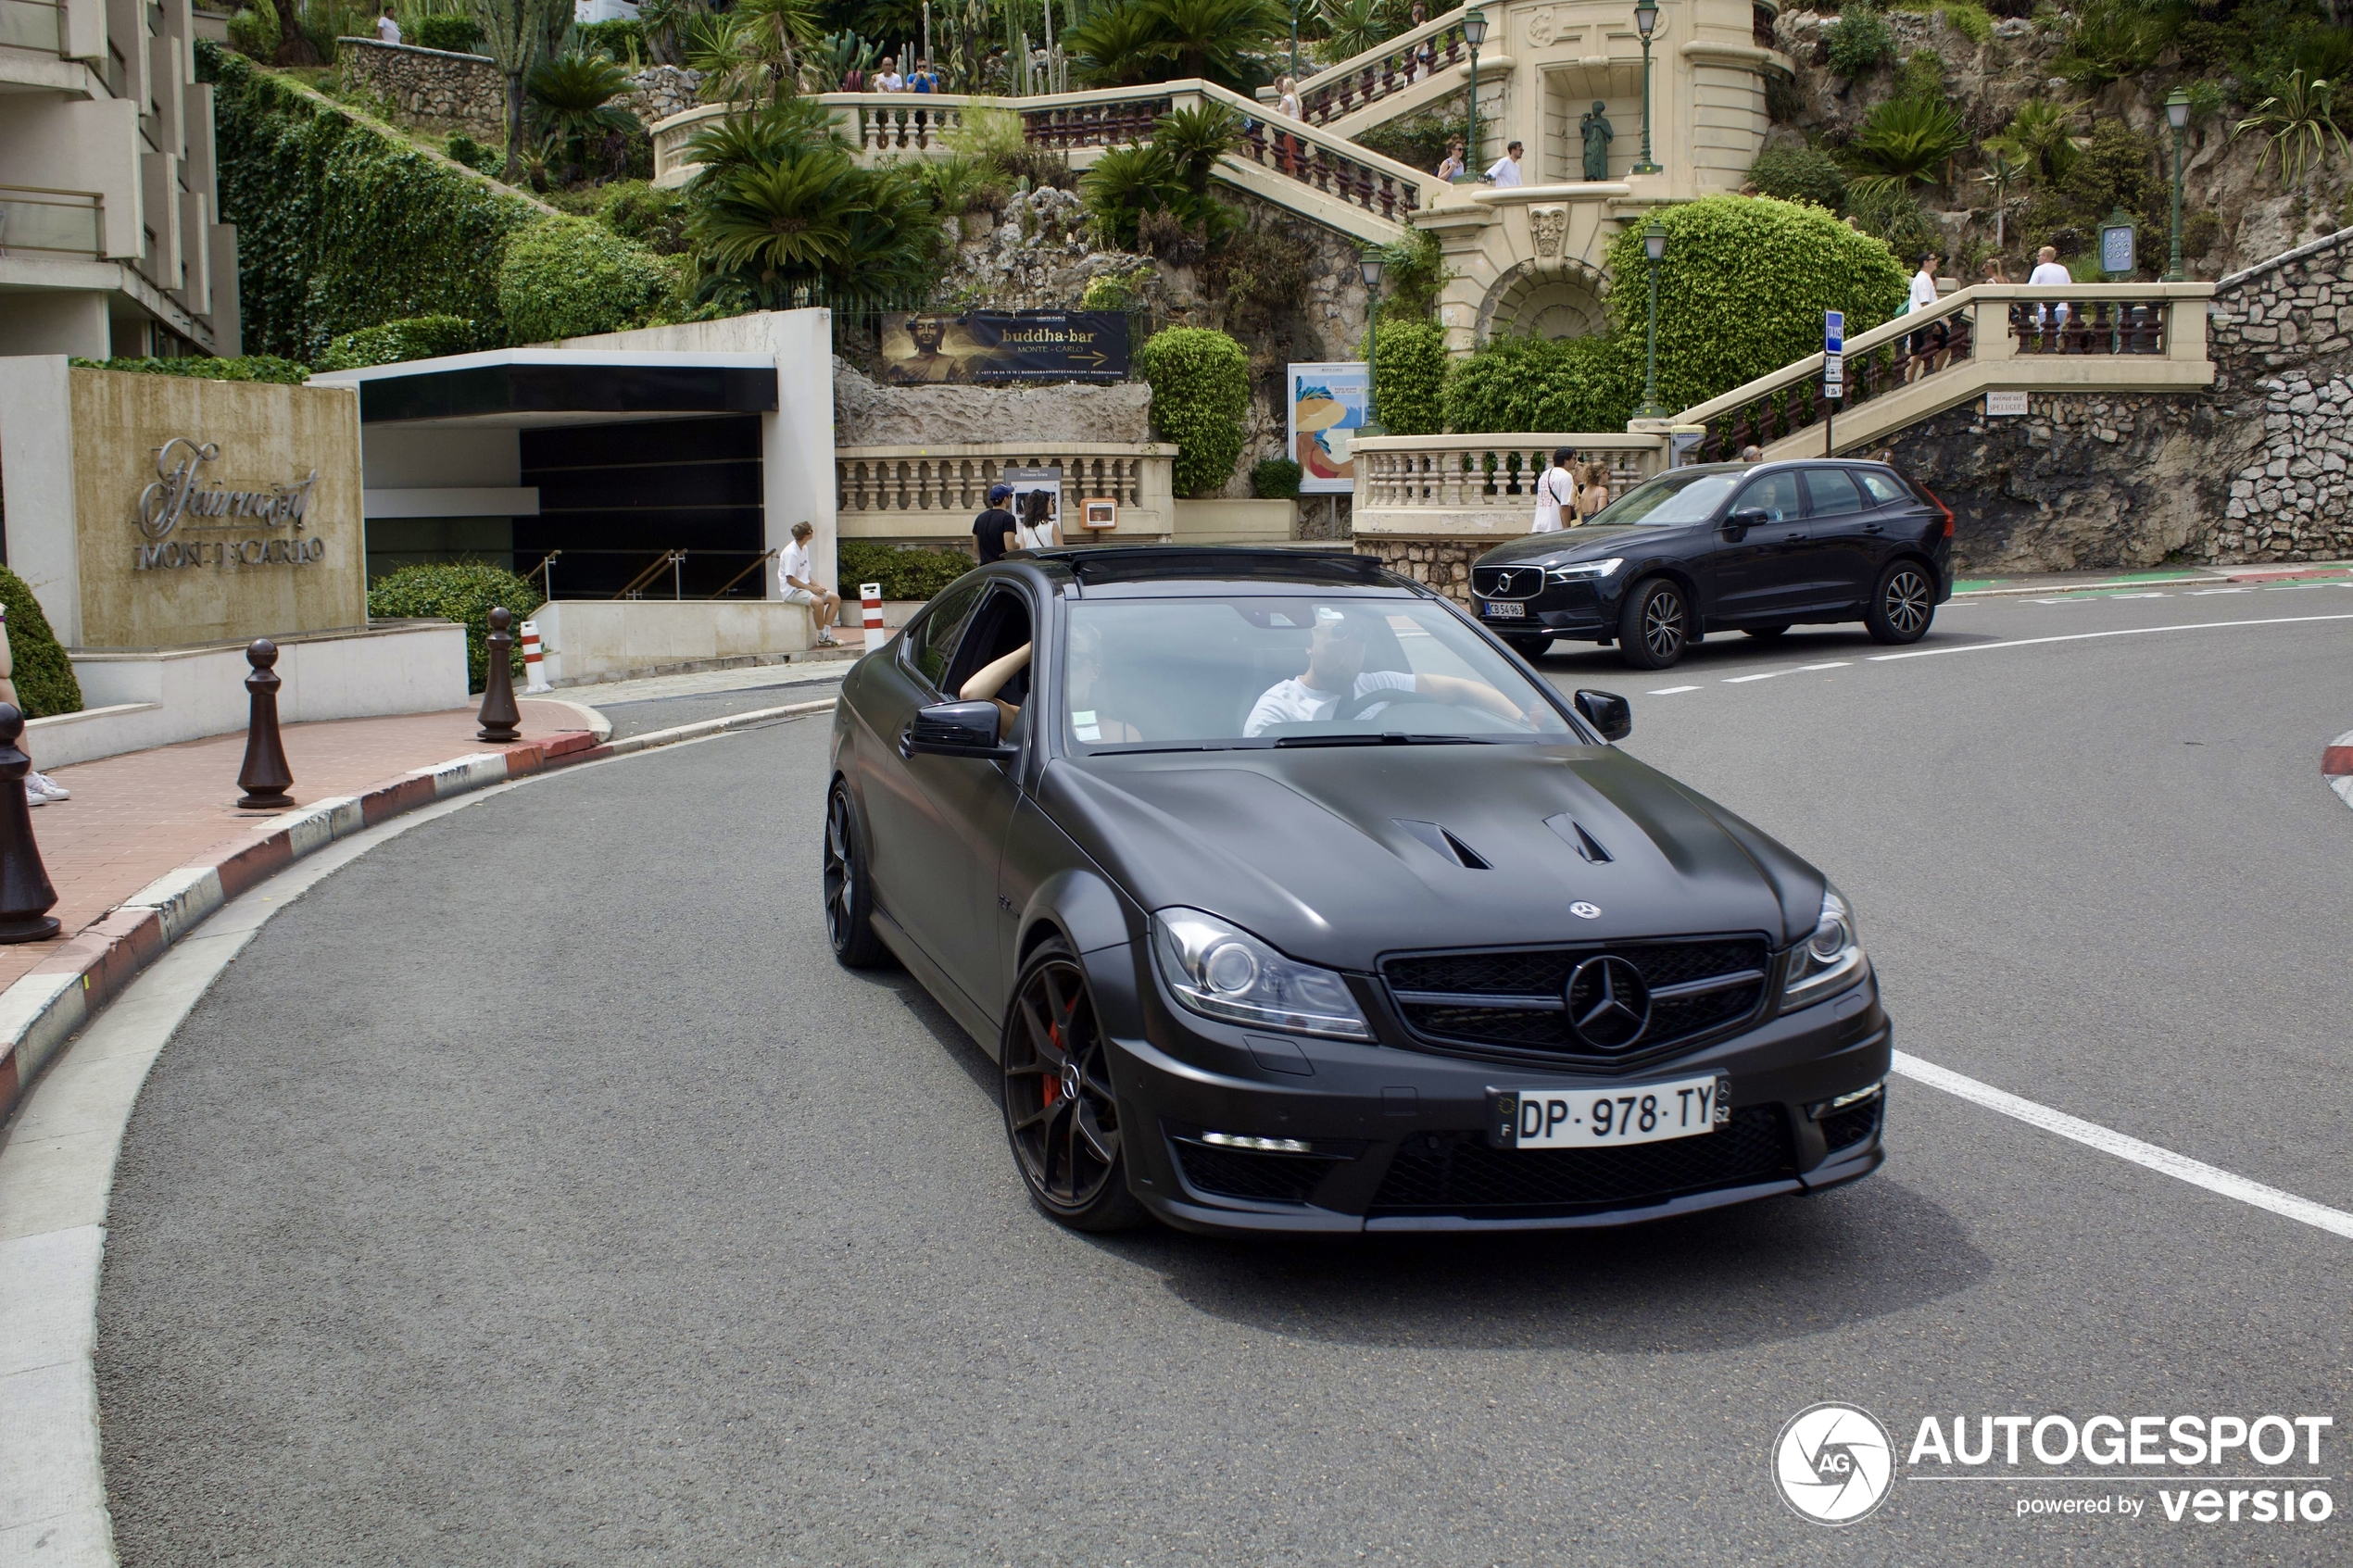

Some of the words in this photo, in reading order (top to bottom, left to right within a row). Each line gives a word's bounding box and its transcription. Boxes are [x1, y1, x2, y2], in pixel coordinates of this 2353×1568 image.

[1002, 328, 1095, 343] buddha-bar
[1828, 326, 1841, 339] TAXIS
[140, 438, 321, 539] Fairmont
[1491, 605, 1500, 614] CB
[1501, 605, 1509, 614] 54
[1510, 605, 1523, 615] 963
[1714, 1106, 1731, 1124] 62
[1501, 1123, 1511, 1137] F
